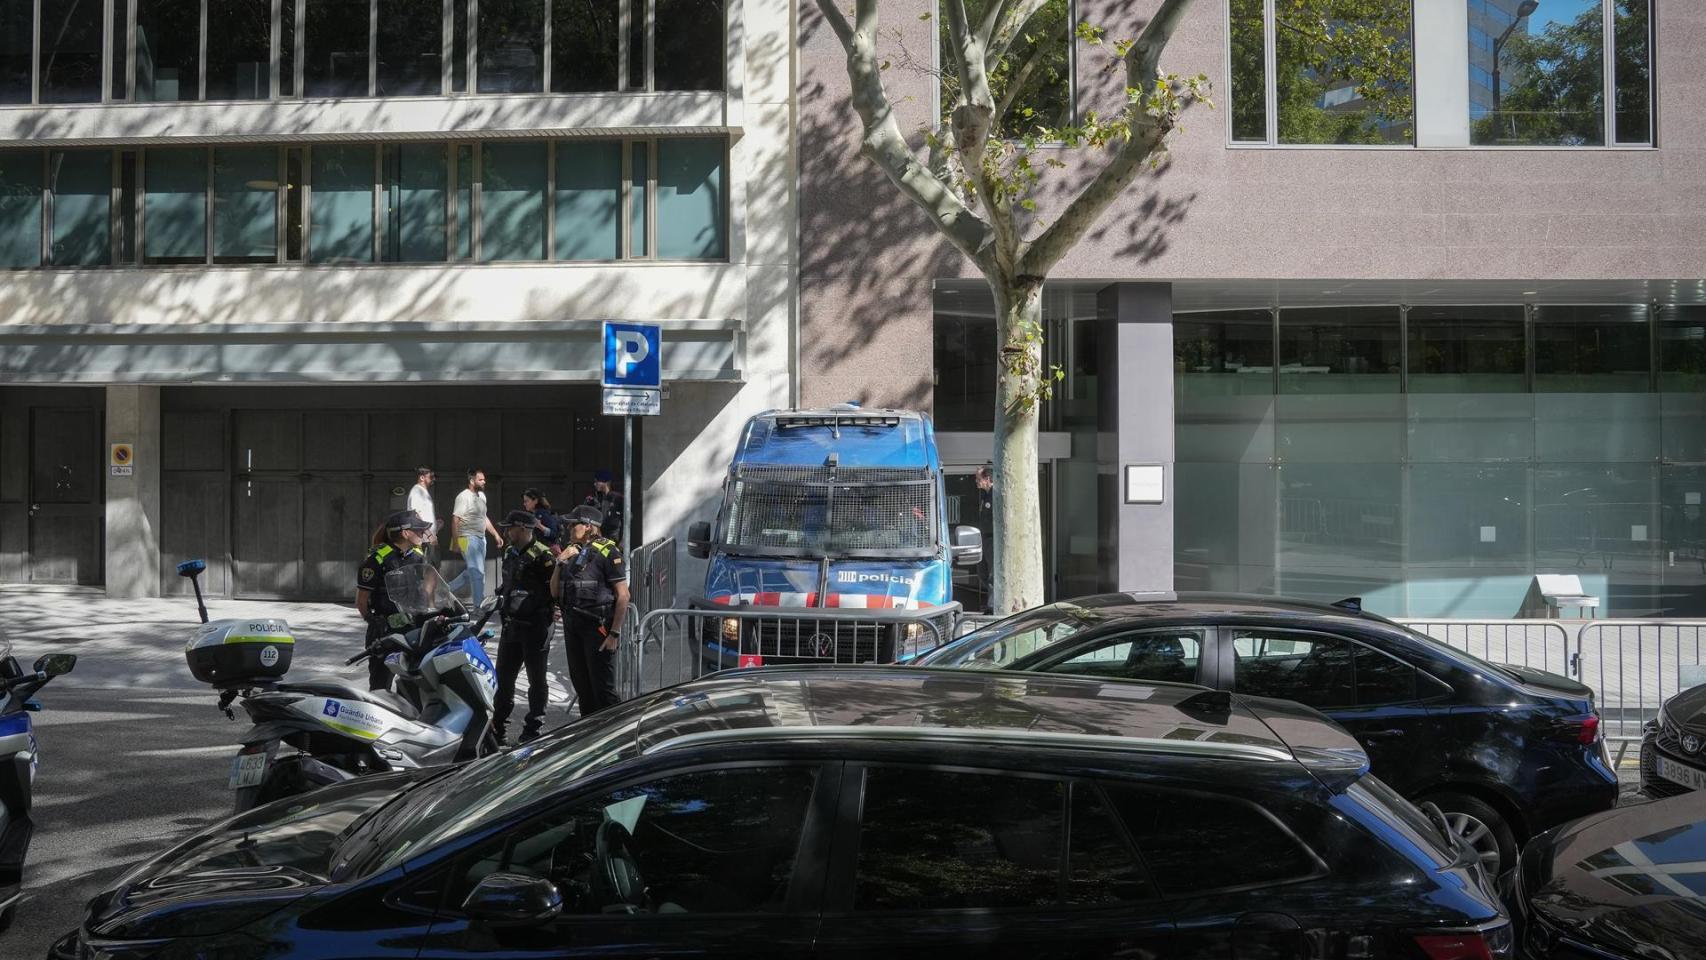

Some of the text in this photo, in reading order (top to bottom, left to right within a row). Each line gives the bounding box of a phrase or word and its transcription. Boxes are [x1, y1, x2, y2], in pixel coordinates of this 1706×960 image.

[615, 330, 649, 378] P
[263, 650, 277, 659] 112
[1663, 761, 1690, 784] 3896
